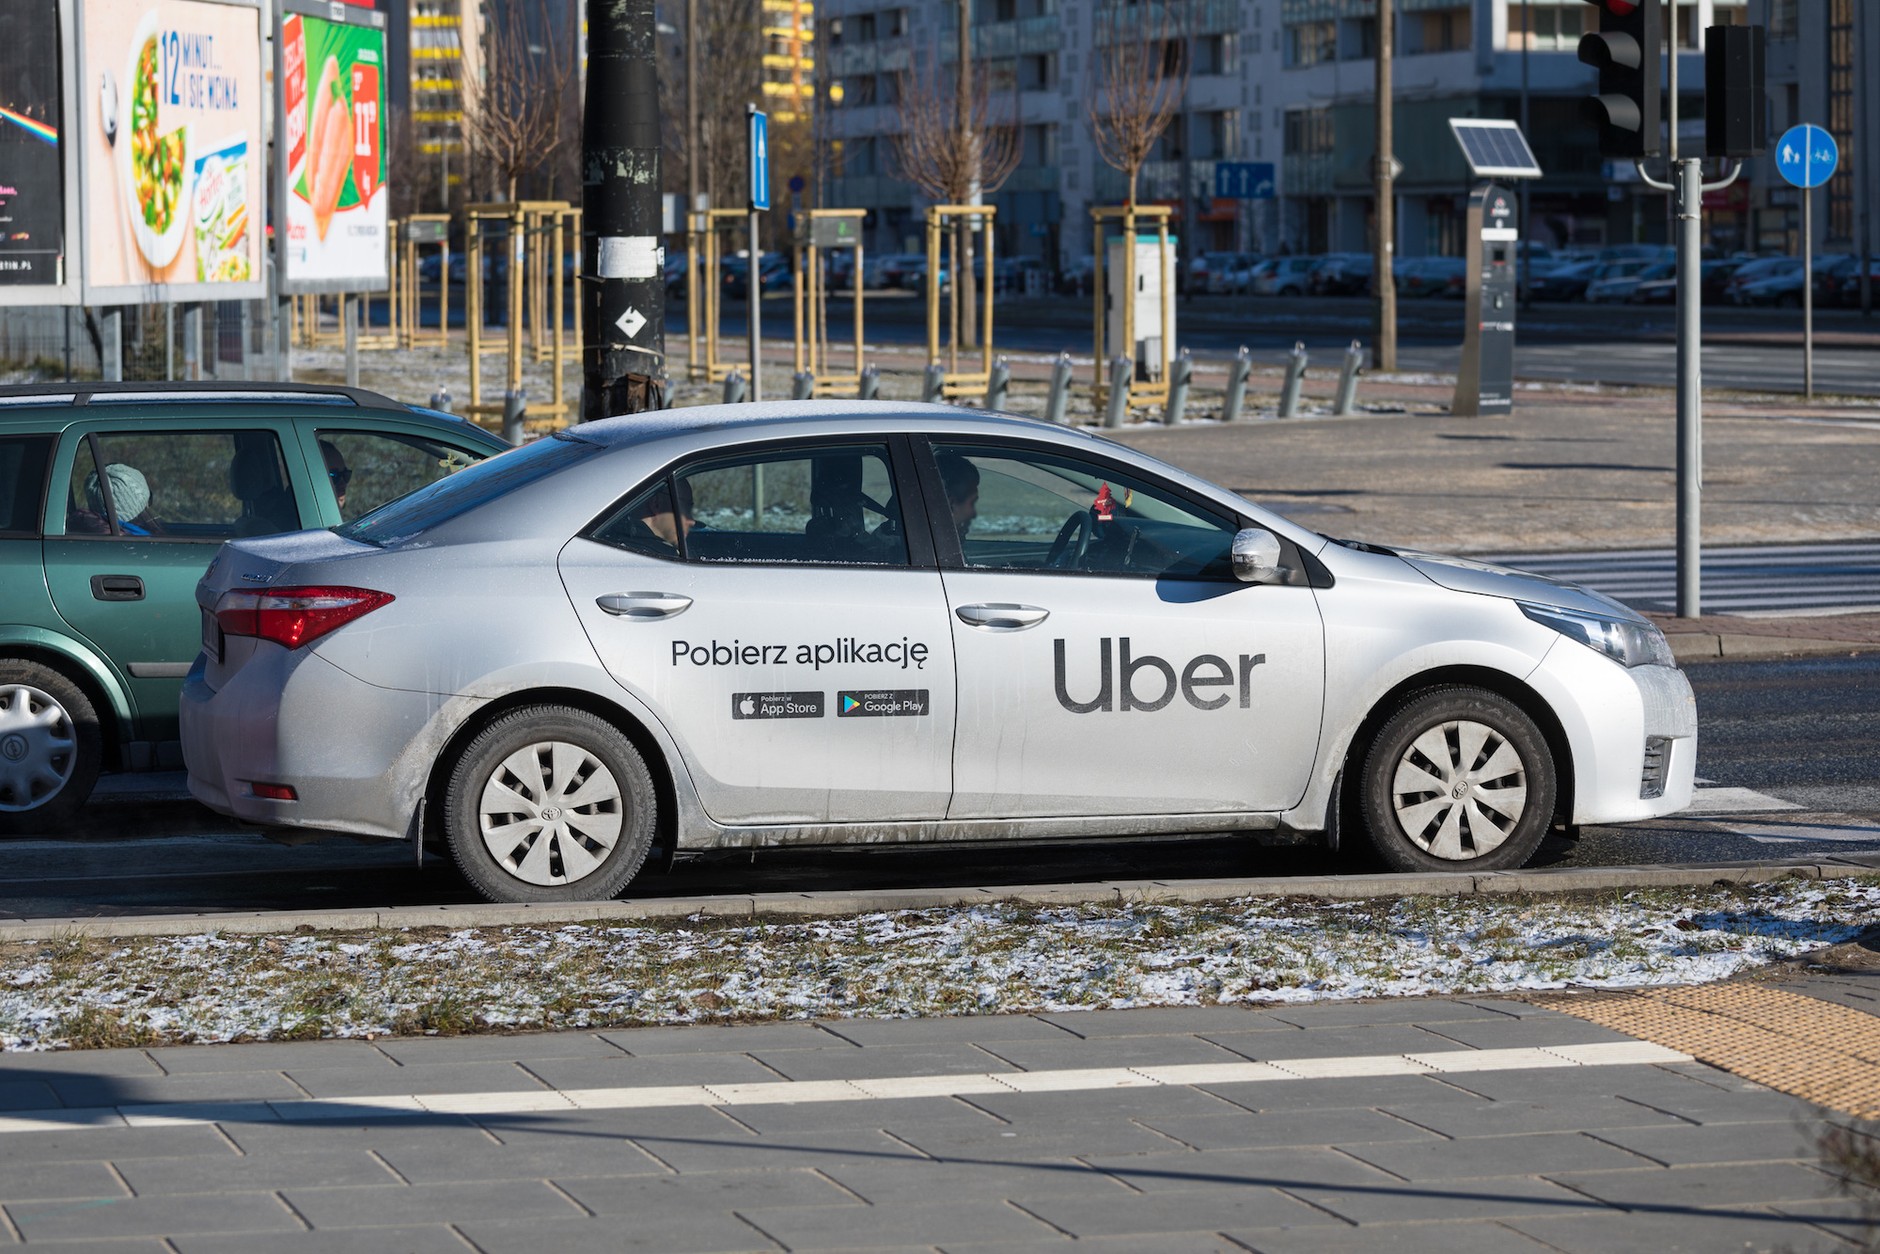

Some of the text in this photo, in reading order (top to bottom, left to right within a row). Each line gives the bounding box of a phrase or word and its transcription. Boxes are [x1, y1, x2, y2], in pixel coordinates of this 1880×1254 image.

[161, 30, 180, 105] 12
[208, 75, 239, 110] WCINA
[671, 637, 929, 671] Pobierz aplikację
[1053, 637, 1266, 714] Uber
[760, 695, 785, 703] Pobierz
[760, 703, 817, 715] App Store
[864, 700, 924, 714] Google Play
